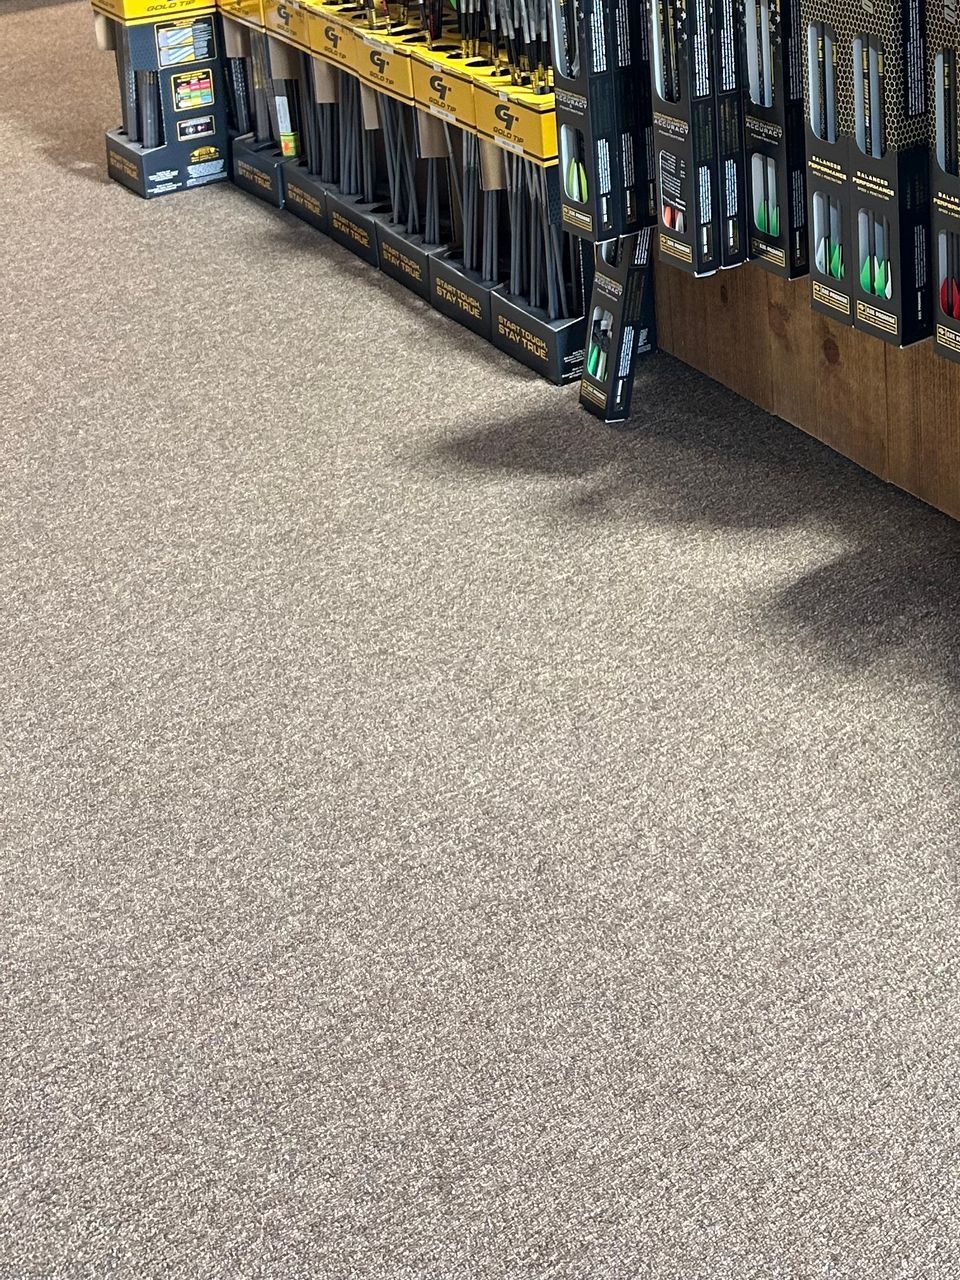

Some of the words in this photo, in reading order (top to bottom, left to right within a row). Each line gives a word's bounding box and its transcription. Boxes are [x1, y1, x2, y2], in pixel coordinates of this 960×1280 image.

[492, 125, 512, 140] GOLD
[512, 133, 525, 144] TIP
[435, 276, 457, 294] START
[436, 285, 458, 305] STAY
[498, 314, 521, 333] START
[498, 324, 521, 344] STAY
